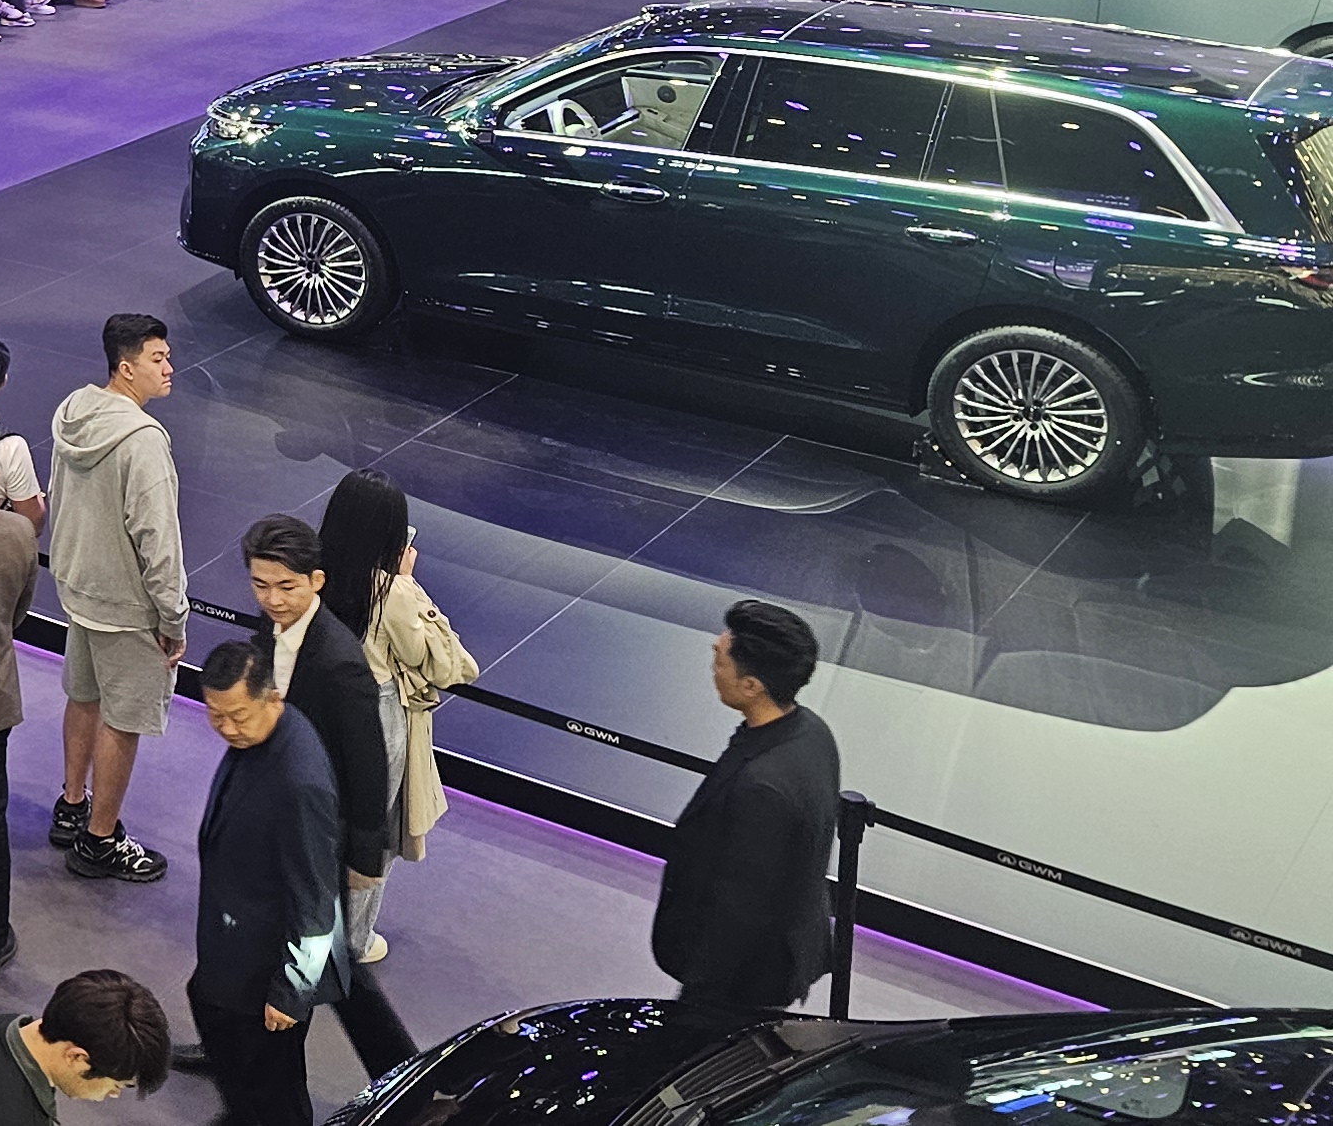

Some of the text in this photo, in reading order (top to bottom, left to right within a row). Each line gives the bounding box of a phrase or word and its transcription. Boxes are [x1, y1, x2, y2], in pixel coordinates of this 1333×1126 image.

[206, 606, 236, 621] GWM
[584, 726, 620, 744] GWM
[1018, 860, 1062, 881] GWM
[1254, 935, 1302, 957] GWM
